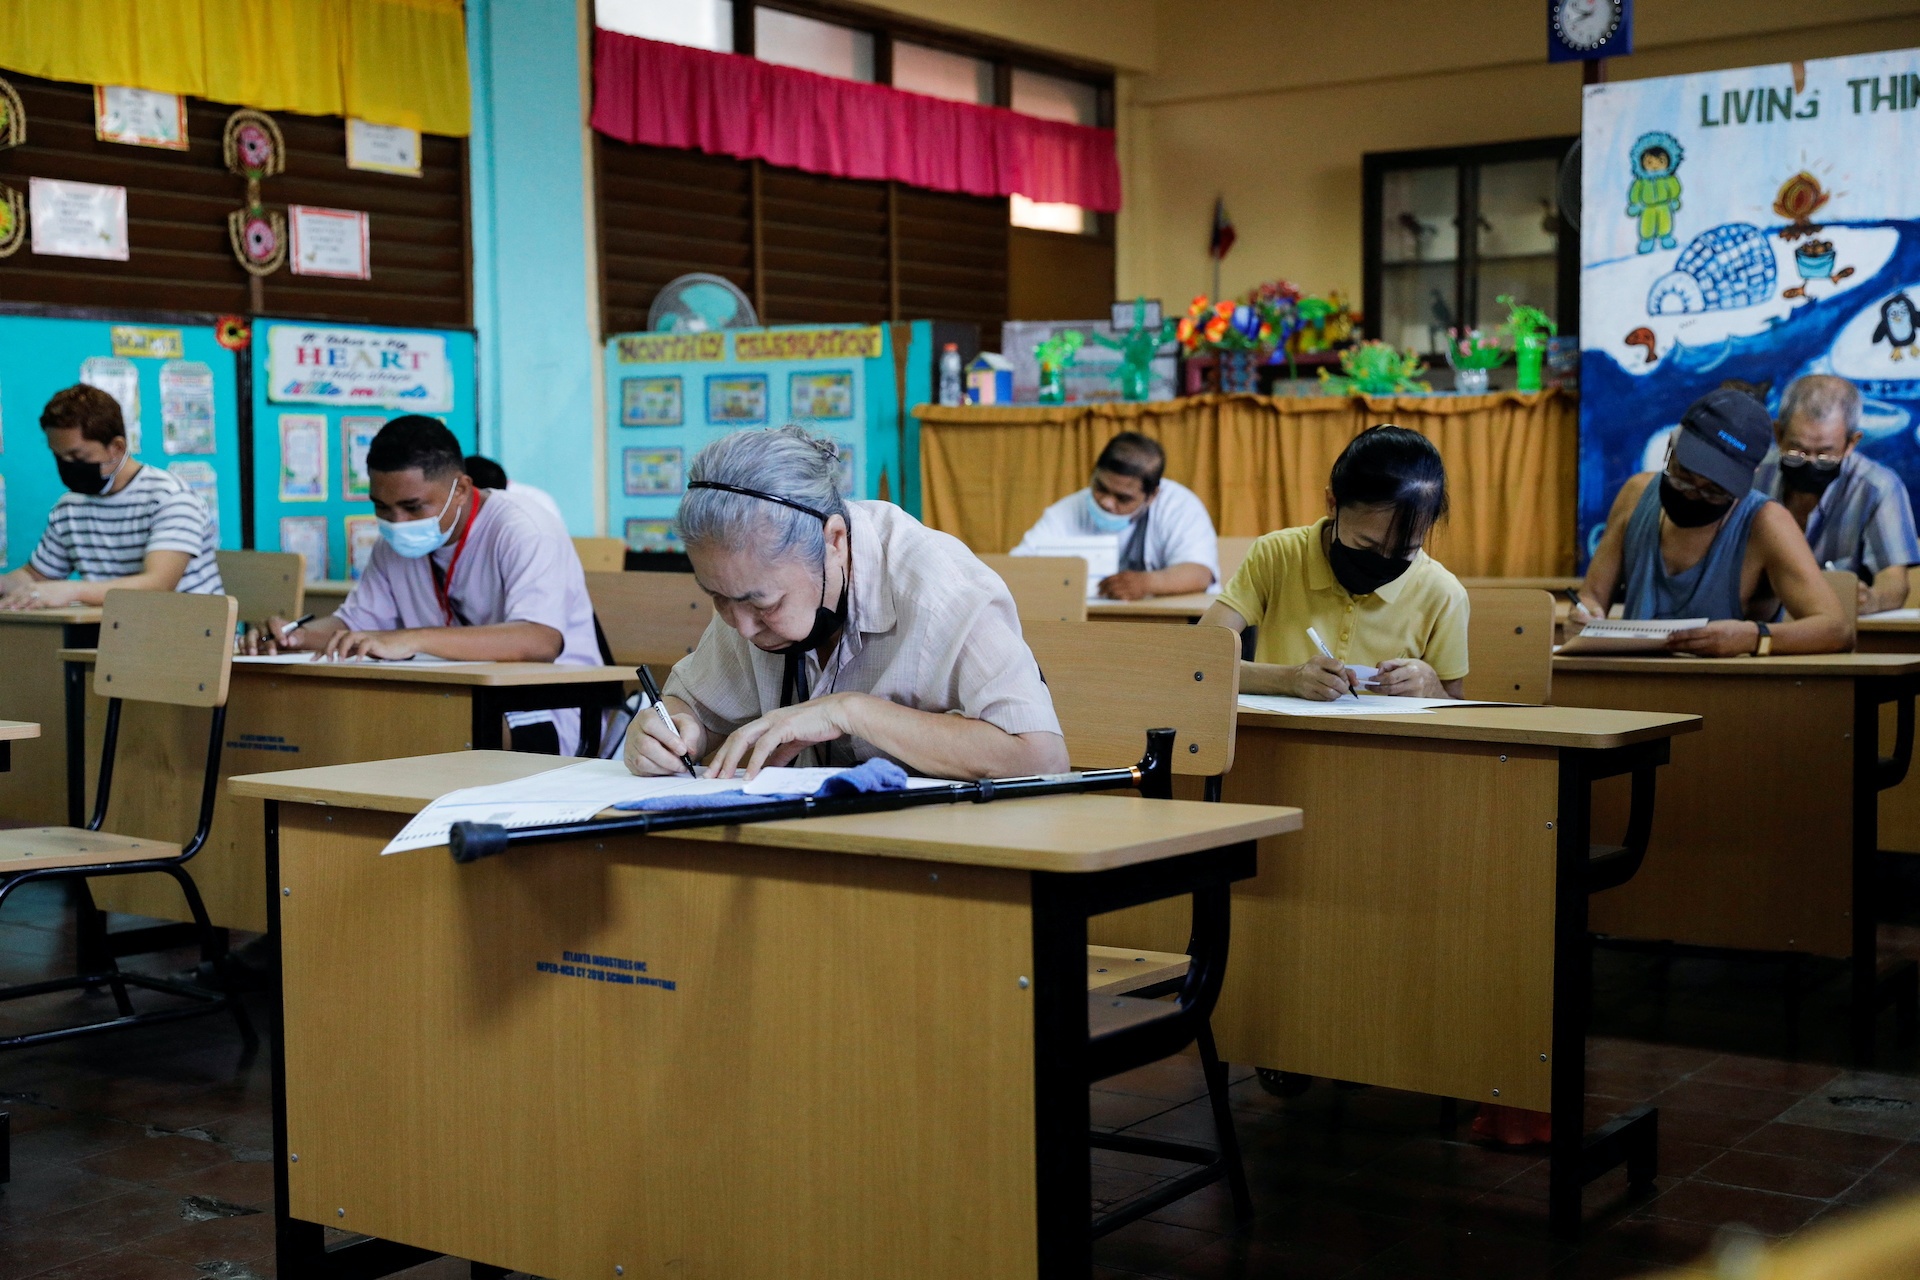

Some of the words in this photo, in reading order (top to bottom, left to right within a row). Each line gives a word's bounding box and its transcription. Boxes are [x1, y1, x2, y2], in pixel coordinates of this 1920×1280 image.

[297, 347, 429, 370] HEART
[563, 951, 591, 963] ATLANTA
[592, 956, 633, 970] INDUSTRIES
